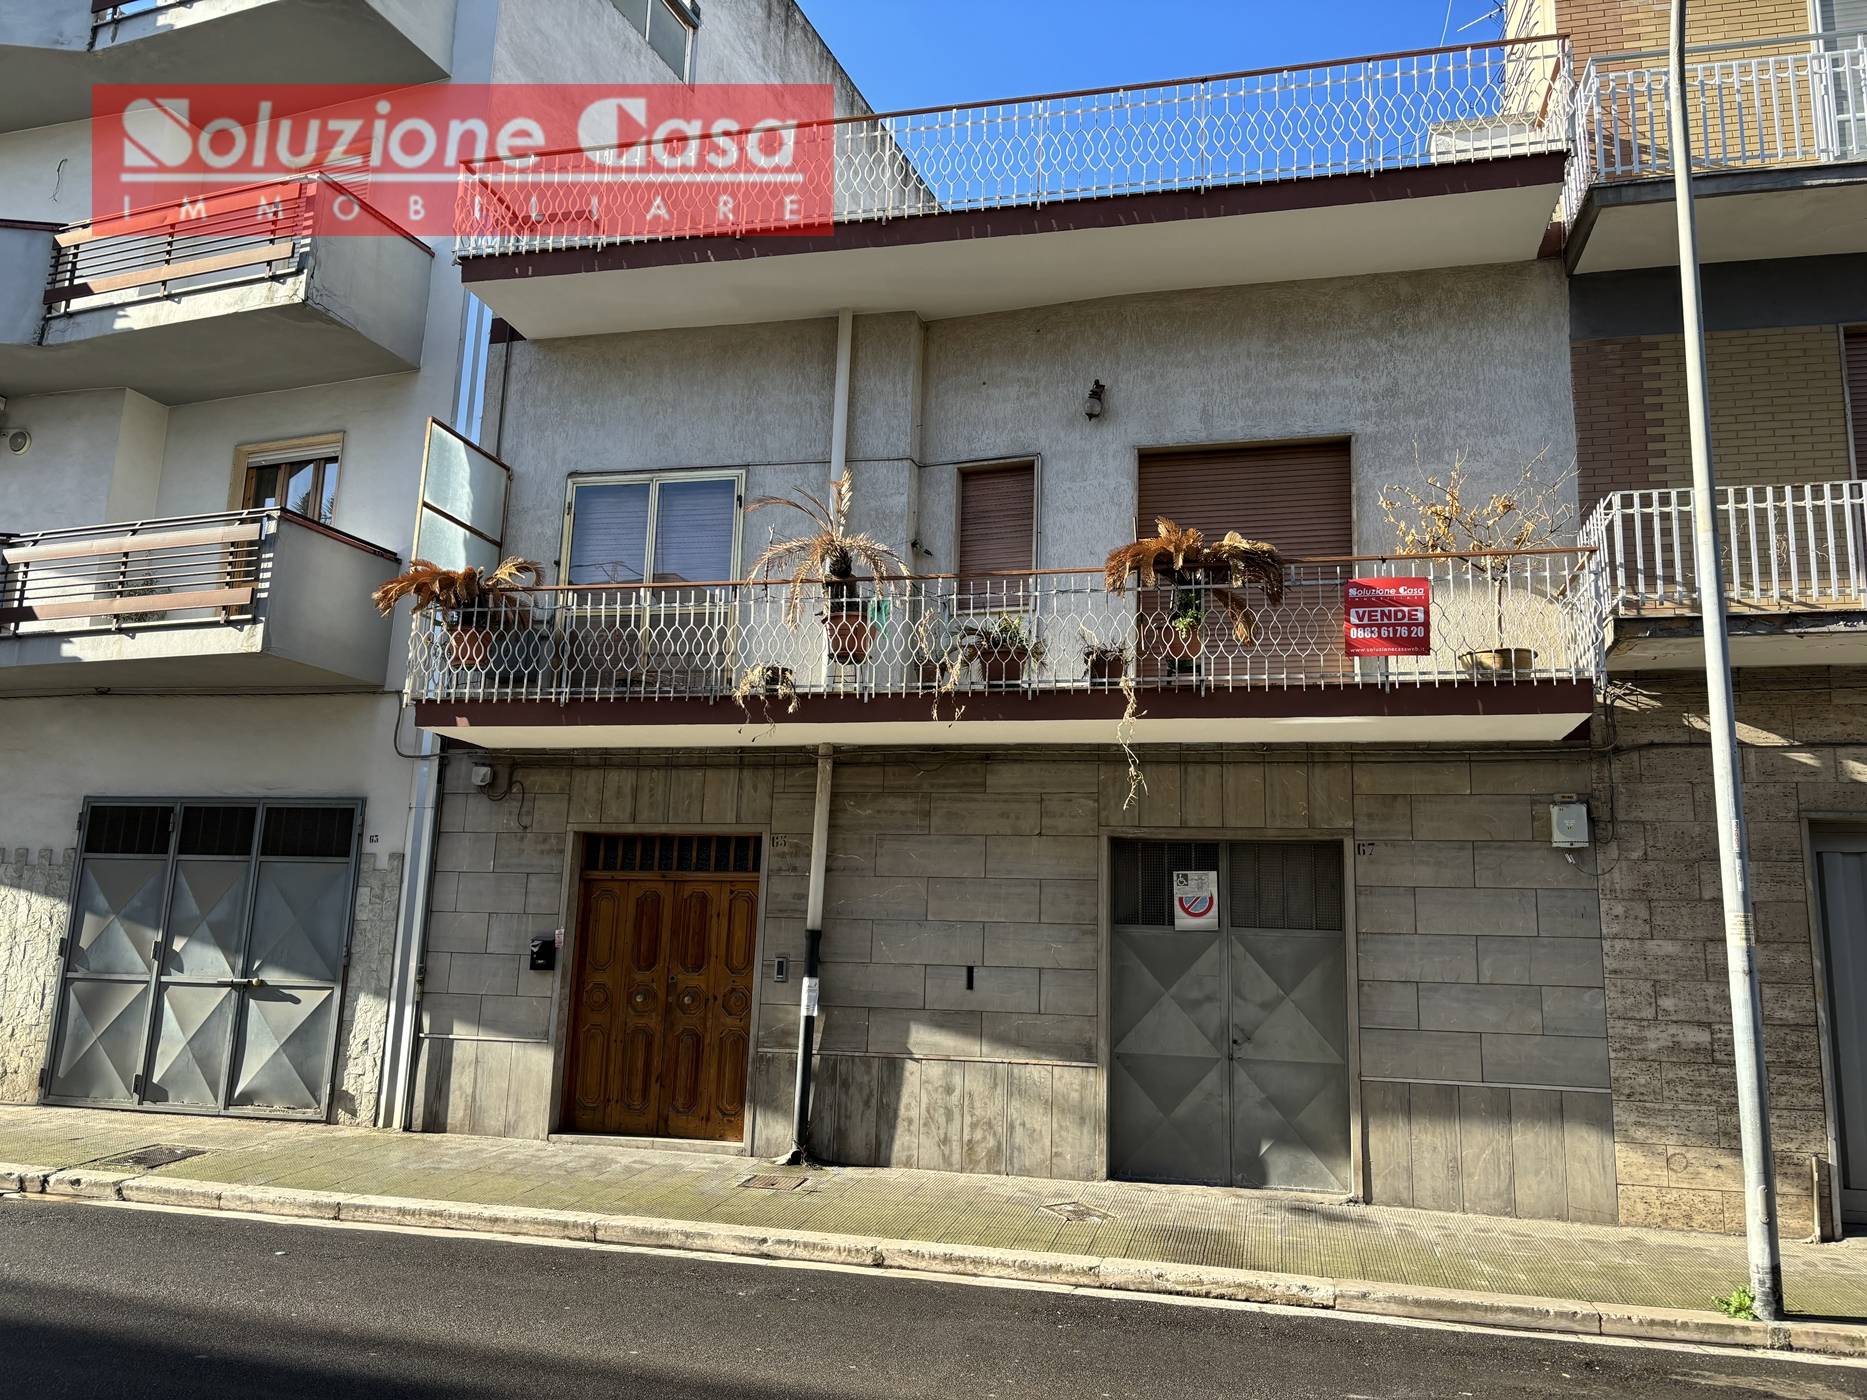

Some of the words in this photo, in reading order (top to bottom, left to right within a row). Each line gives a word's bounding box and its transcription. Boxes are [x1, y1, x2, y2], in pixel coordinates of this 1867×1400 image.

[1349, 587, 1396, 596] Soluzione
[1399, 586, 1424, 595] Casa
[1354, 608, 1419, 623] VENDE
[1410, 626, 1424, 638] 20
[1357, 842, 1376, 856] 67
